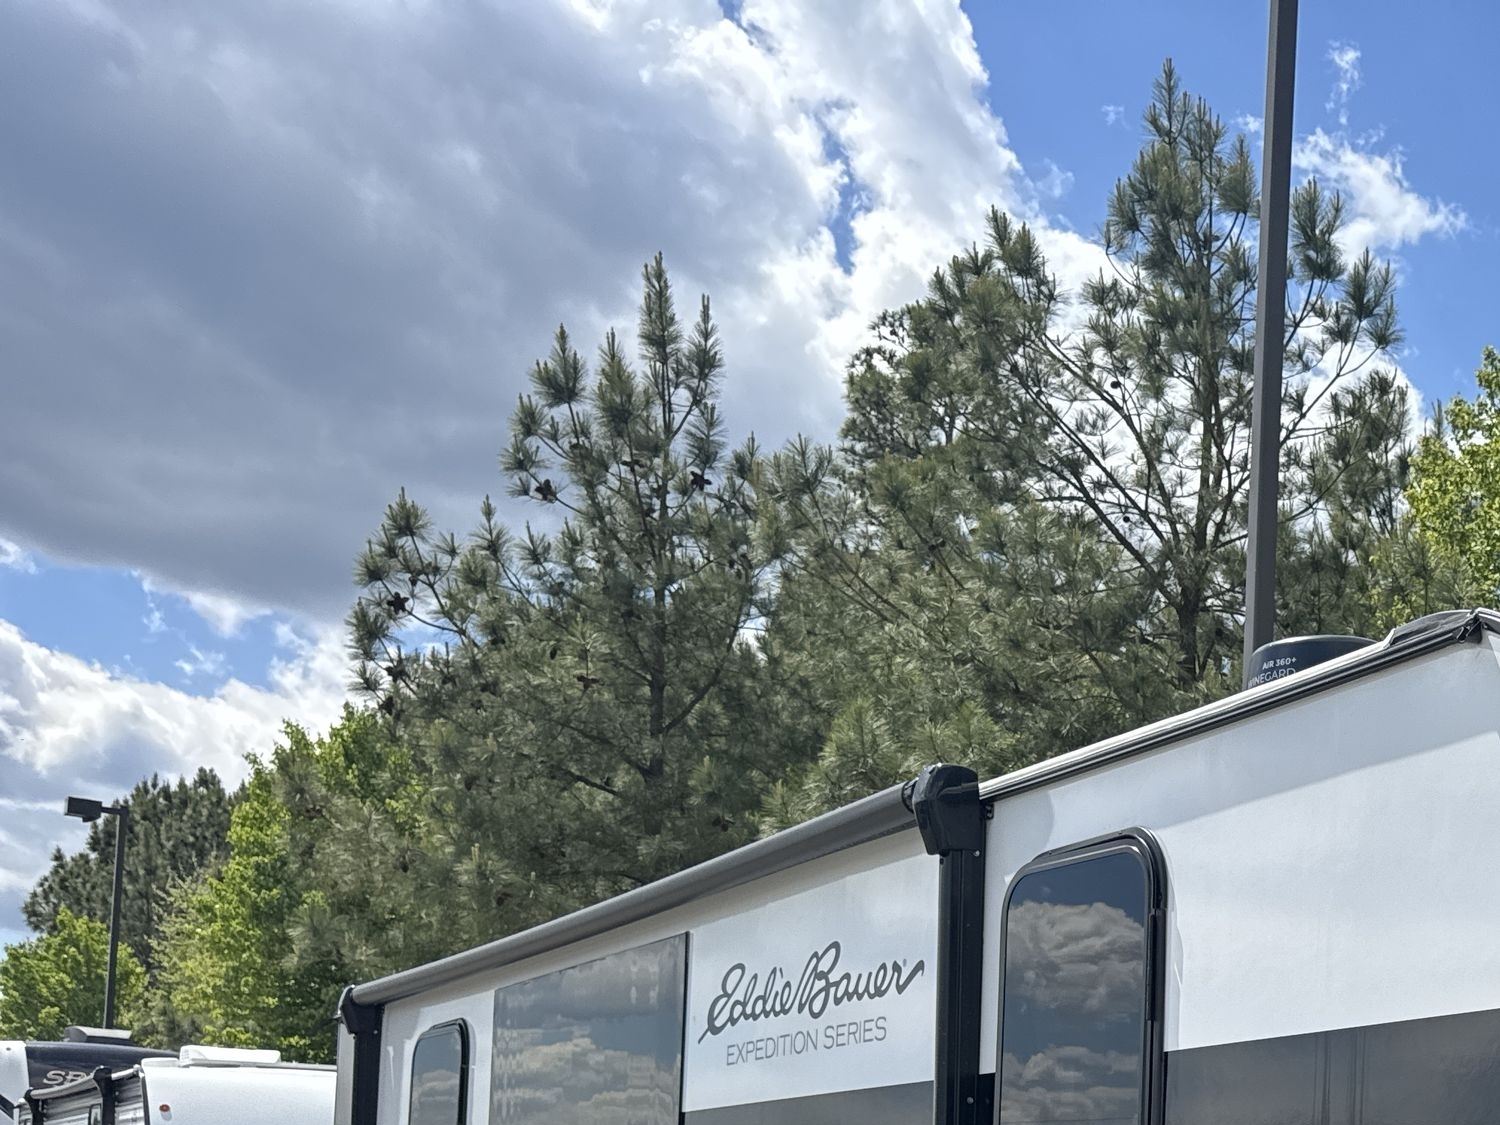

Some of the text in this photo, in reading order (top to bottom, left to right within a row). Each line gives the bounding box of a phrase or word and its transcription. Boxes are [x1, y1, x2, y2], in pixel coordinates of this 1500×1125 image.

[1262, 657, 1297, 670] AIR 360+
[698, 940, 925, 1045] Eddie Bauer
[726, 1016, 887, 1066] EXPEDITION SERIES
